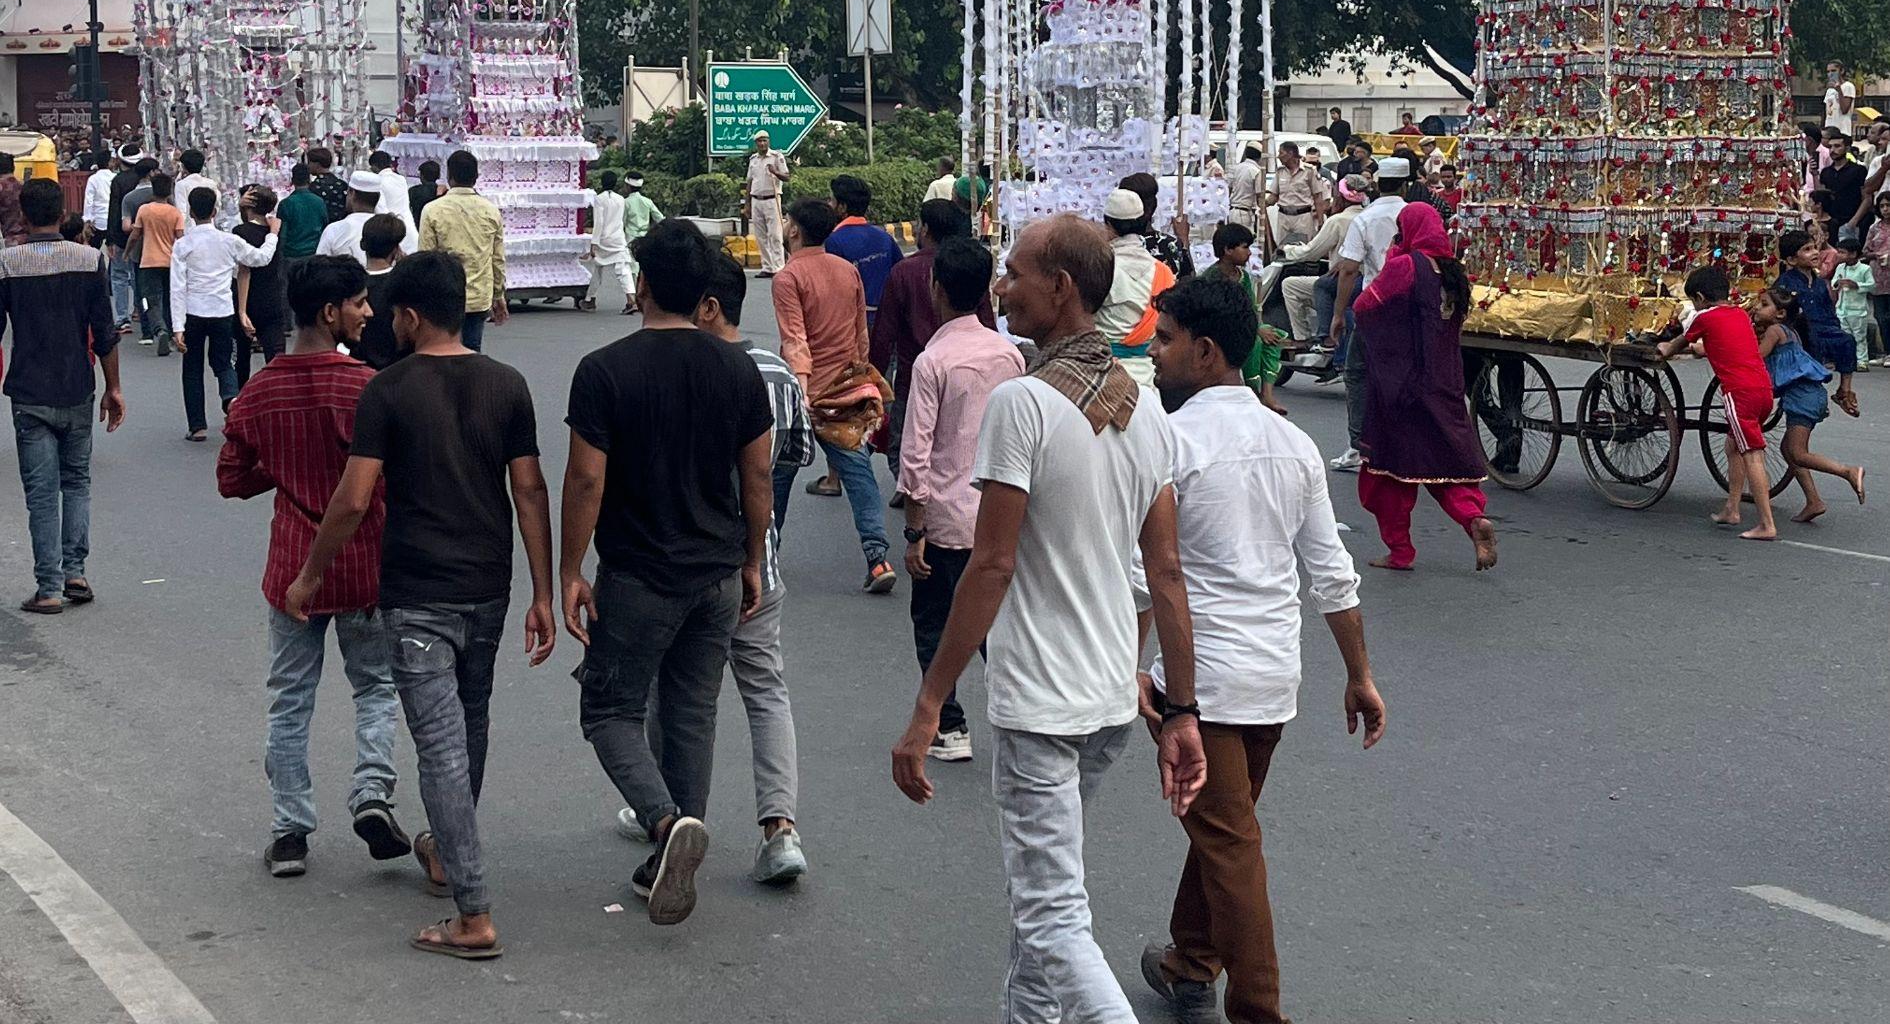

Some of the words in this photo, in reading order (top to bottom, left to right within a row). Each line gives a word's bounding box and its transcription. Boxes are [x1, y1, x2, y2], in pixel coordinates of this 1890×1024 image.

[761, 88, 778, 102] सिंह
[714, 104, 736, 113] BABA
[737, 104, 770, 113] KHARAK
[771, 104, 793, 113] SINGH
[794, 104, 816, 113] MARG
